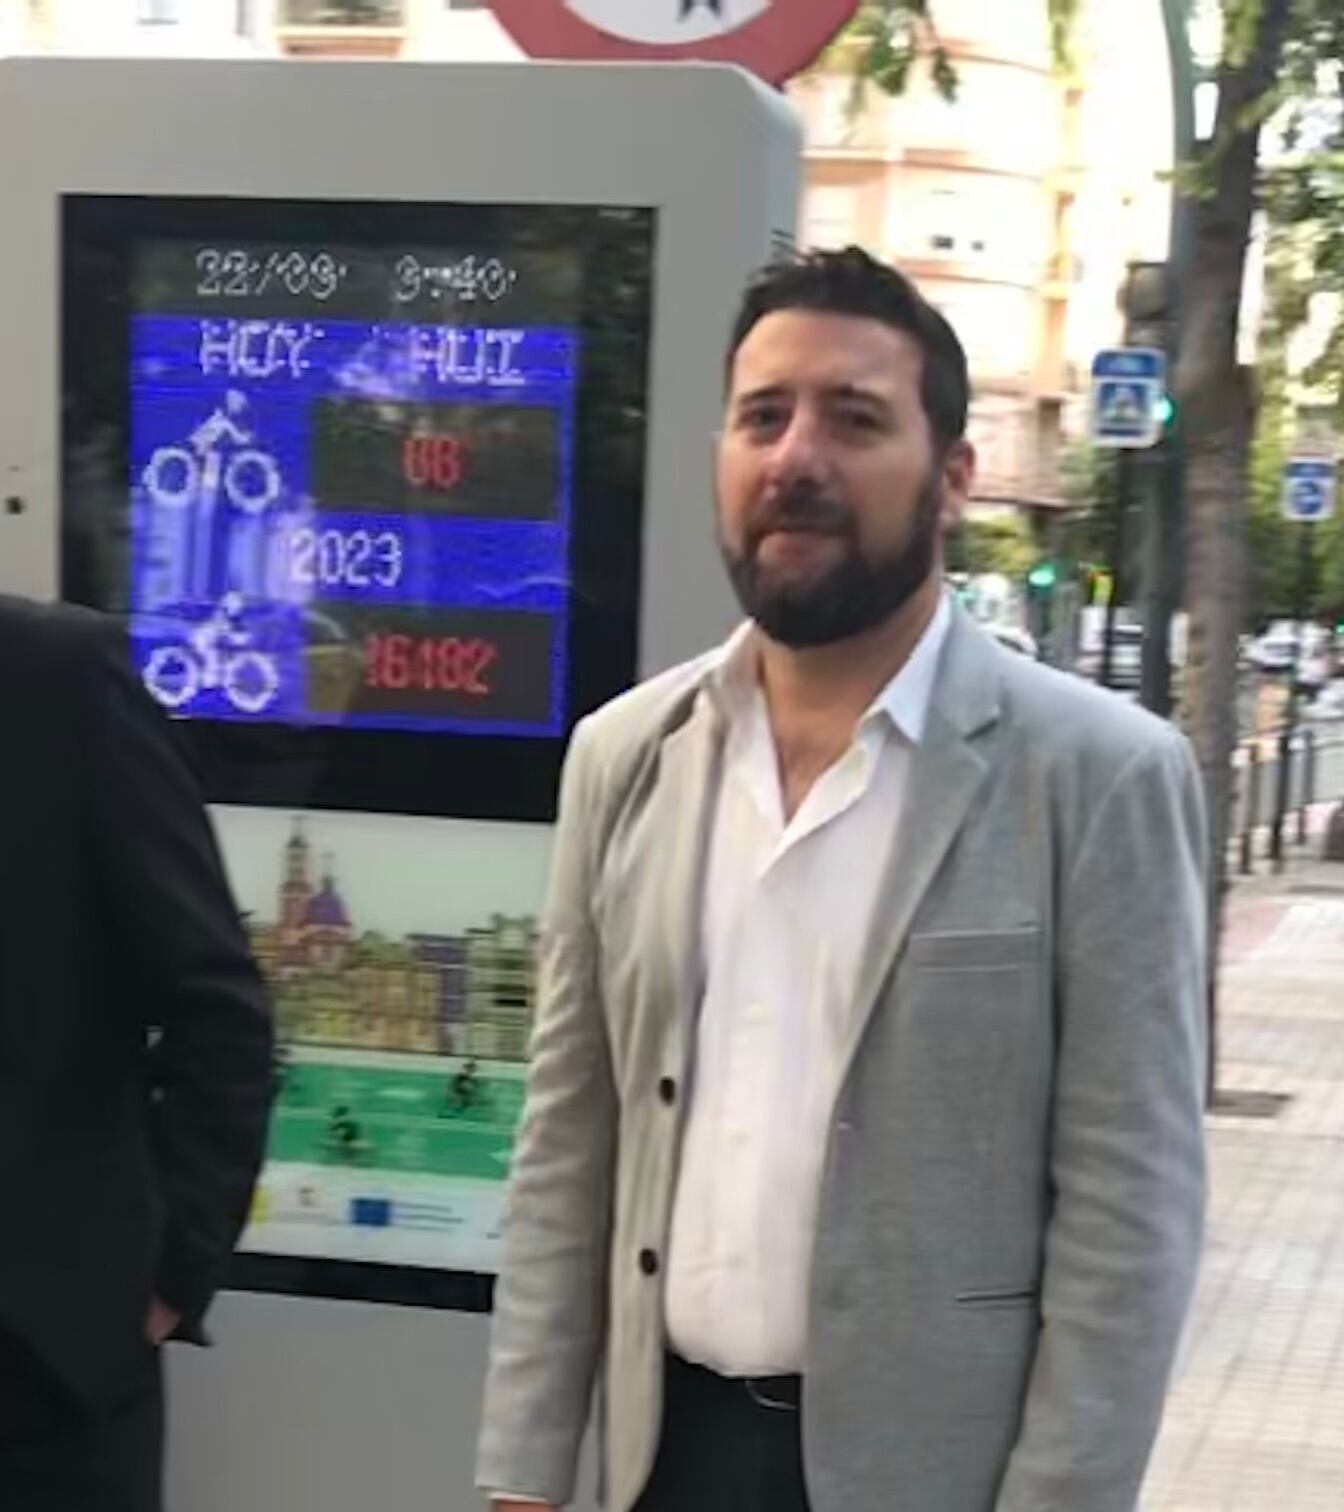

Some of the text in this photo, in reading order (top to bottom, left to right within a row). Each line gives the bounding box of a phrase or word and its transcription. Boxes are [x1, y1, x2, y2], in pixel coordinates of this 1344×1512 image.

[195, 248, 344, 300] 22/09
[198, 318, 322, 378] HOY
[290, 527, 403, 588] 2023
